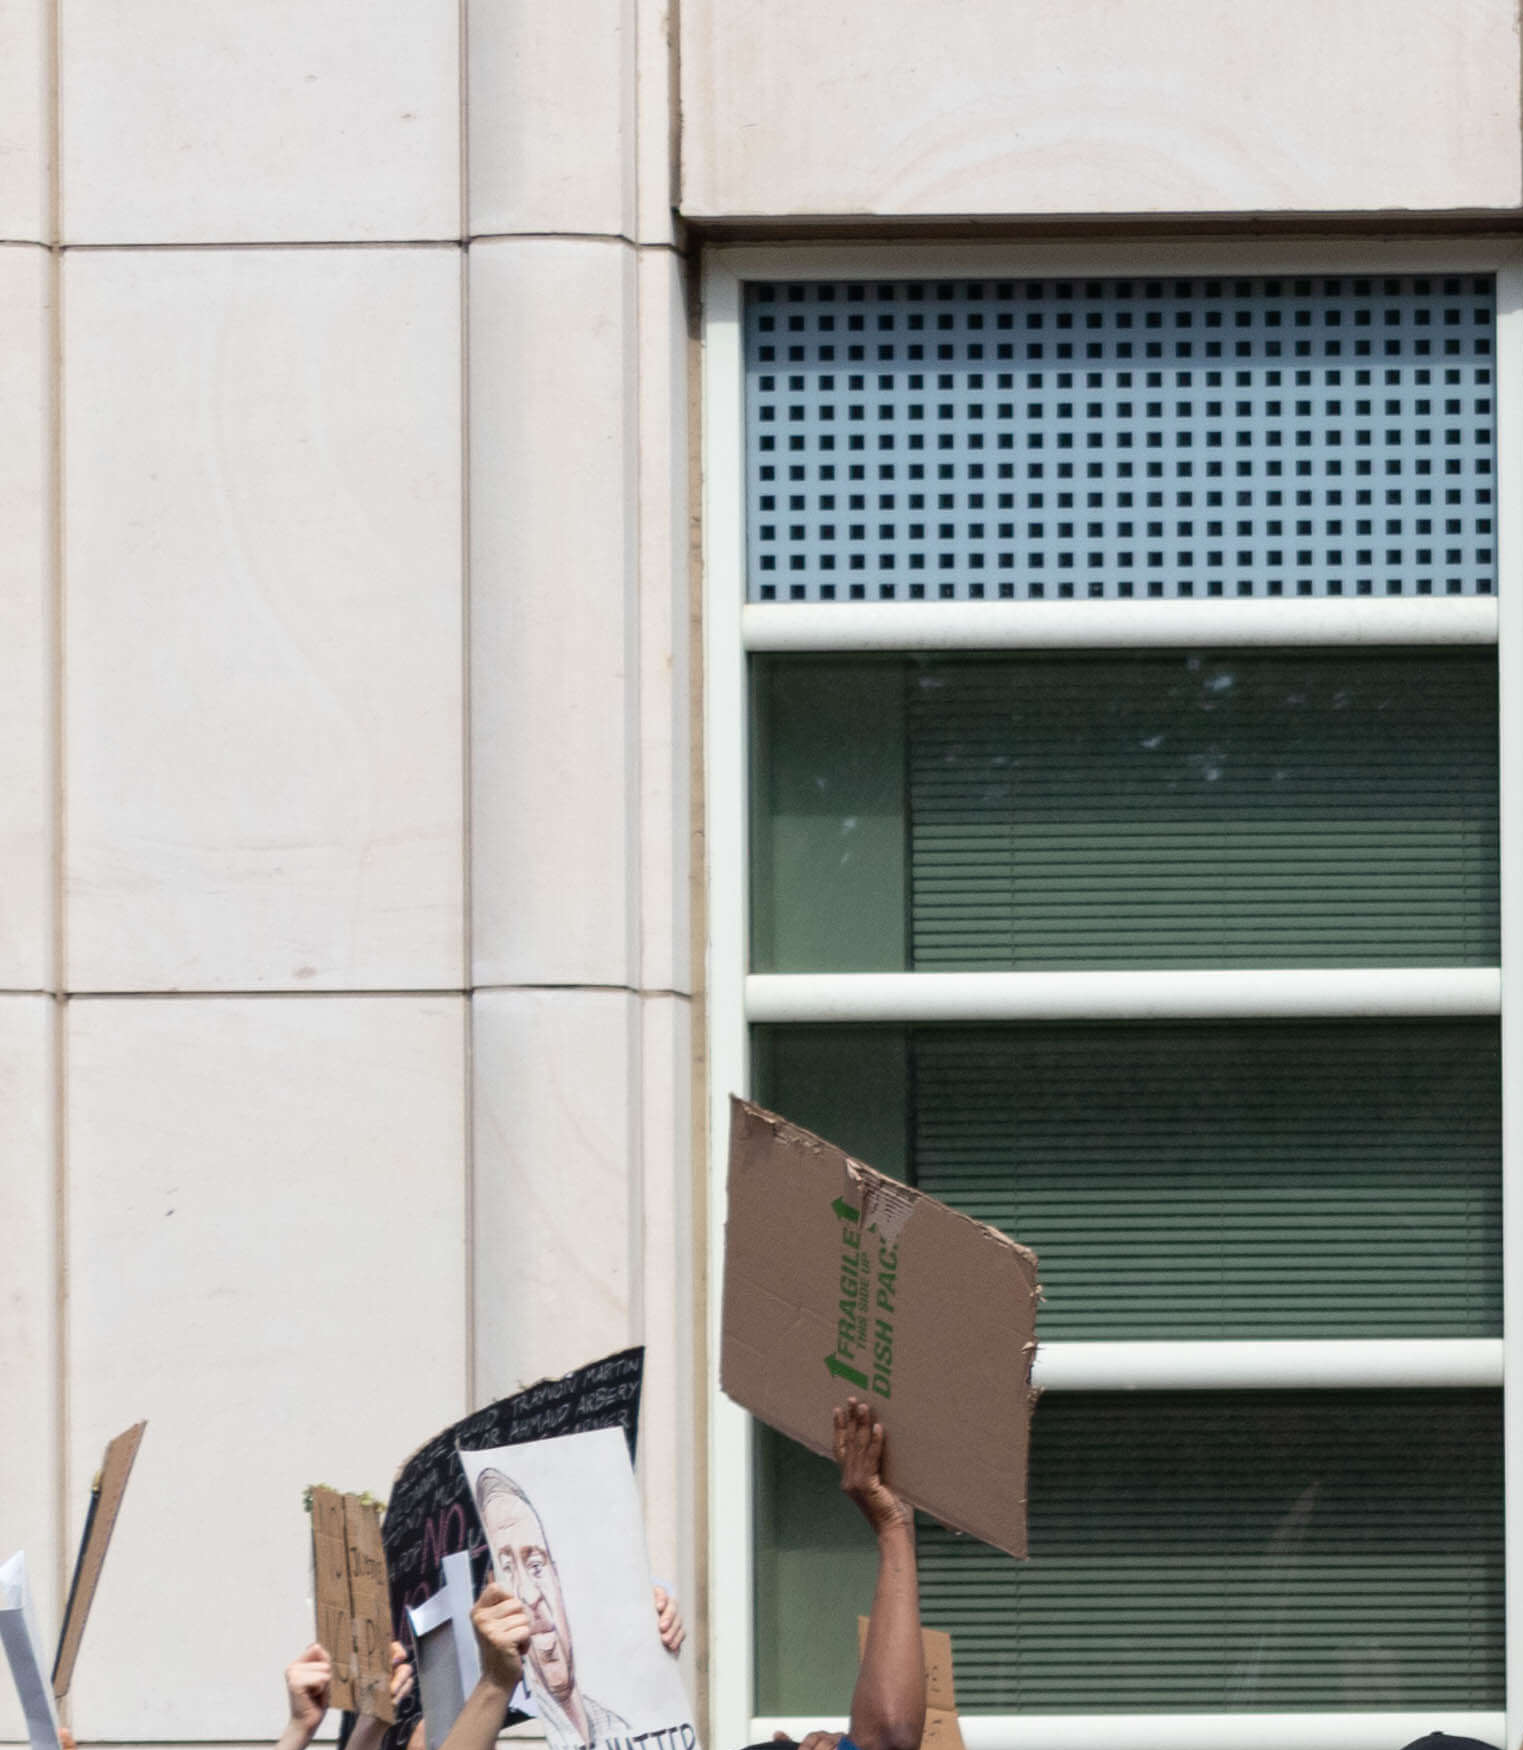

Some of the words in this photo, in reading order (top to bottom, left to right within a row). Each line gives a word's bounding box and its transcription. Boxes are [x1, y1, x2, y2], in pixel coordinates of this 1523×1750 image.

[858, 1251, 870, 1276] UP
[837, 1226, 861, 1361] FRAGILE
[857, 1279, 870, 1313] SIDE
[856, 1315, 868, 1351] THIS
[872, 1319, 894, 1399] DISH
